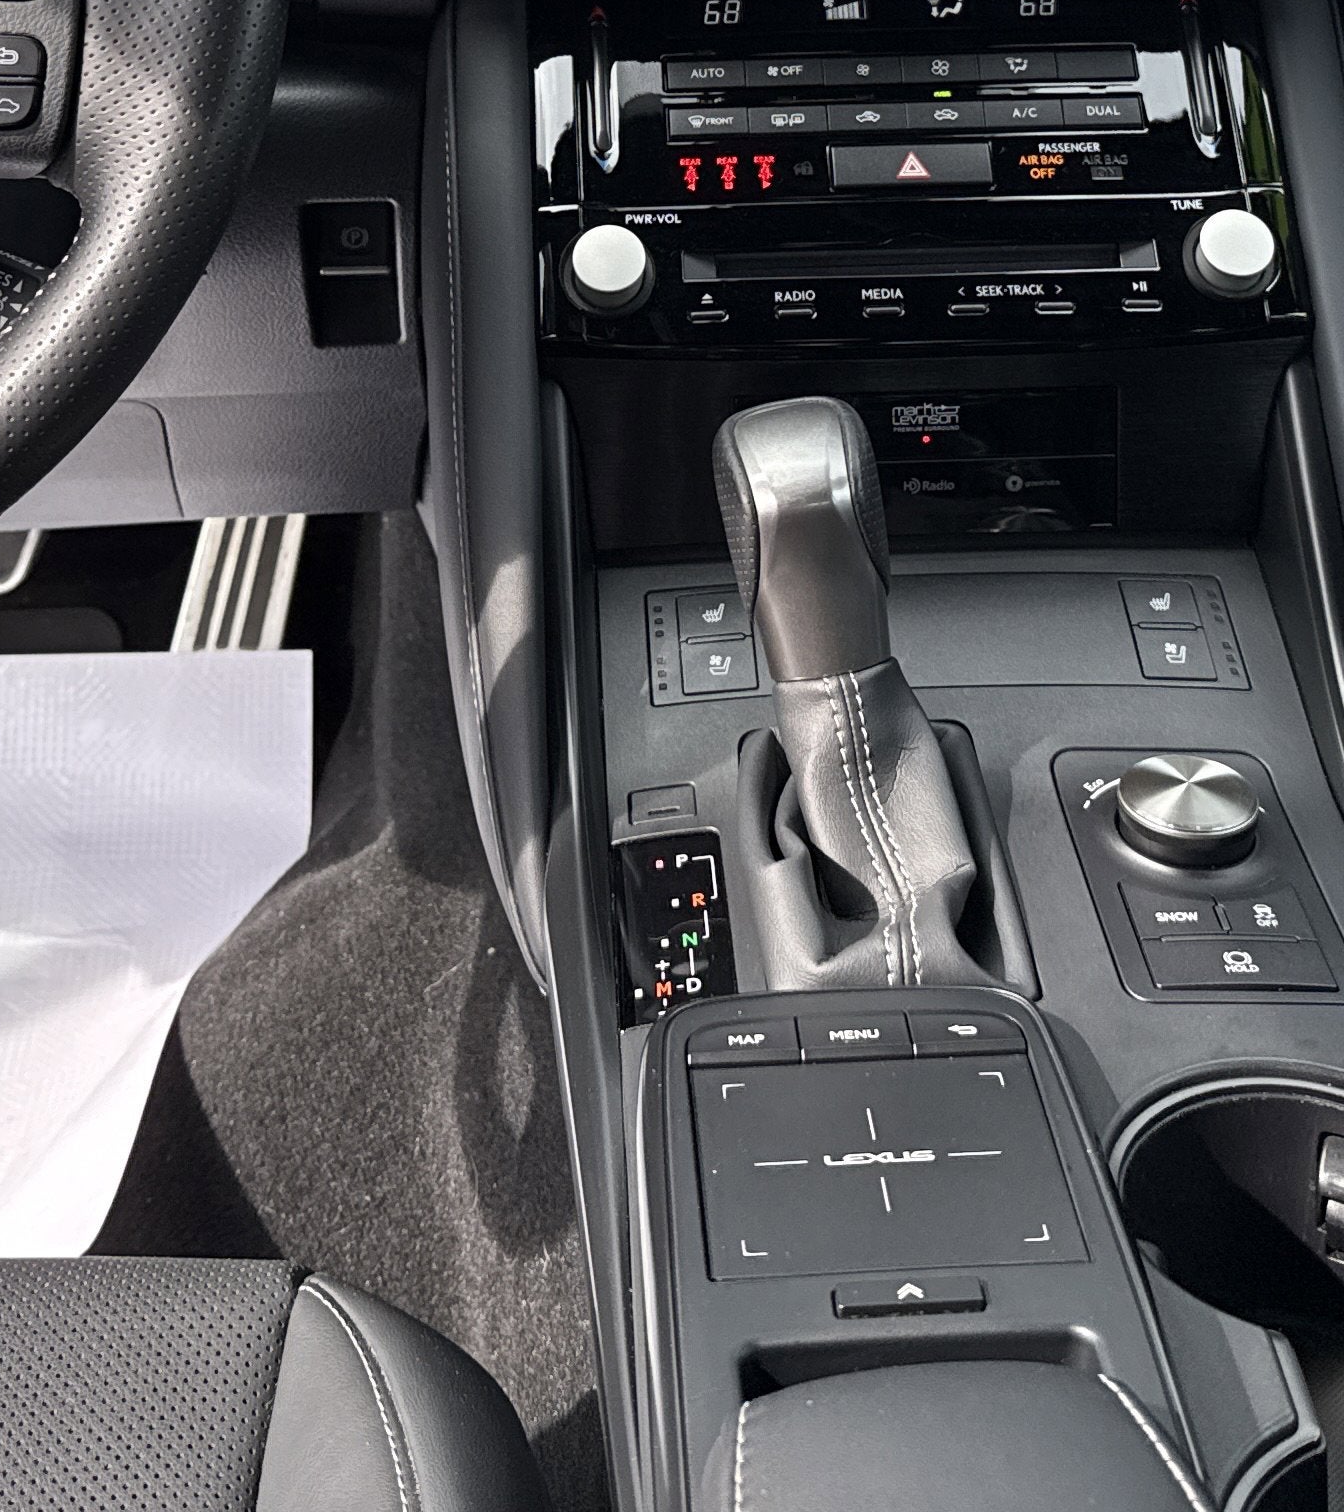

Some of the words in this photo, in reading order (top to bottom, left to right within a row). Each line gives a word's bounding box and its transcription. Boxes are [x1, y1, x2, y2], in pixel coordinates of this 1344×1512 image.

[703, 0, 742, 26] 68
[690, 67, 725, 79] AUTO
[780, 64, 804, 77] OFF
[1011, 107, 1039, 119] A/C
[1085, 105, 1122, 117] DUAL
[705, 115, 734, 126] FRONT
[1038, 142, 1101, 154] PASSENGER
[1018, 154, 1039, 166] AIR
[1040, 154, 1064, 166] BAG
[1029, 168, 1056, 180] OFF
[1170, 199, 1204, 211] TUNE
[774, 289, 816, 303] RADIO
[861, 288, 904, 301] MEDIA
[922, 479, 955, 491] Radio
[1083, 778, 1105, 793] Eco
[675, 853, 689, 868] P
[692, 892, 706, 908] R
[1155, 911, 1199, 922] SNOW
[1256, 919, 1279, 928] OFF
[681, 931, 698, 948] N
[1224, 964, 1260, 973] HOLD
[656, 980, 673, 998] M
[686, 977, 702, 994] D
[727, 1033, 766, 1047] MAP
[829, 1027, 880, 1041] MENU
[823, 1149, 936, 1166] LEXUS
